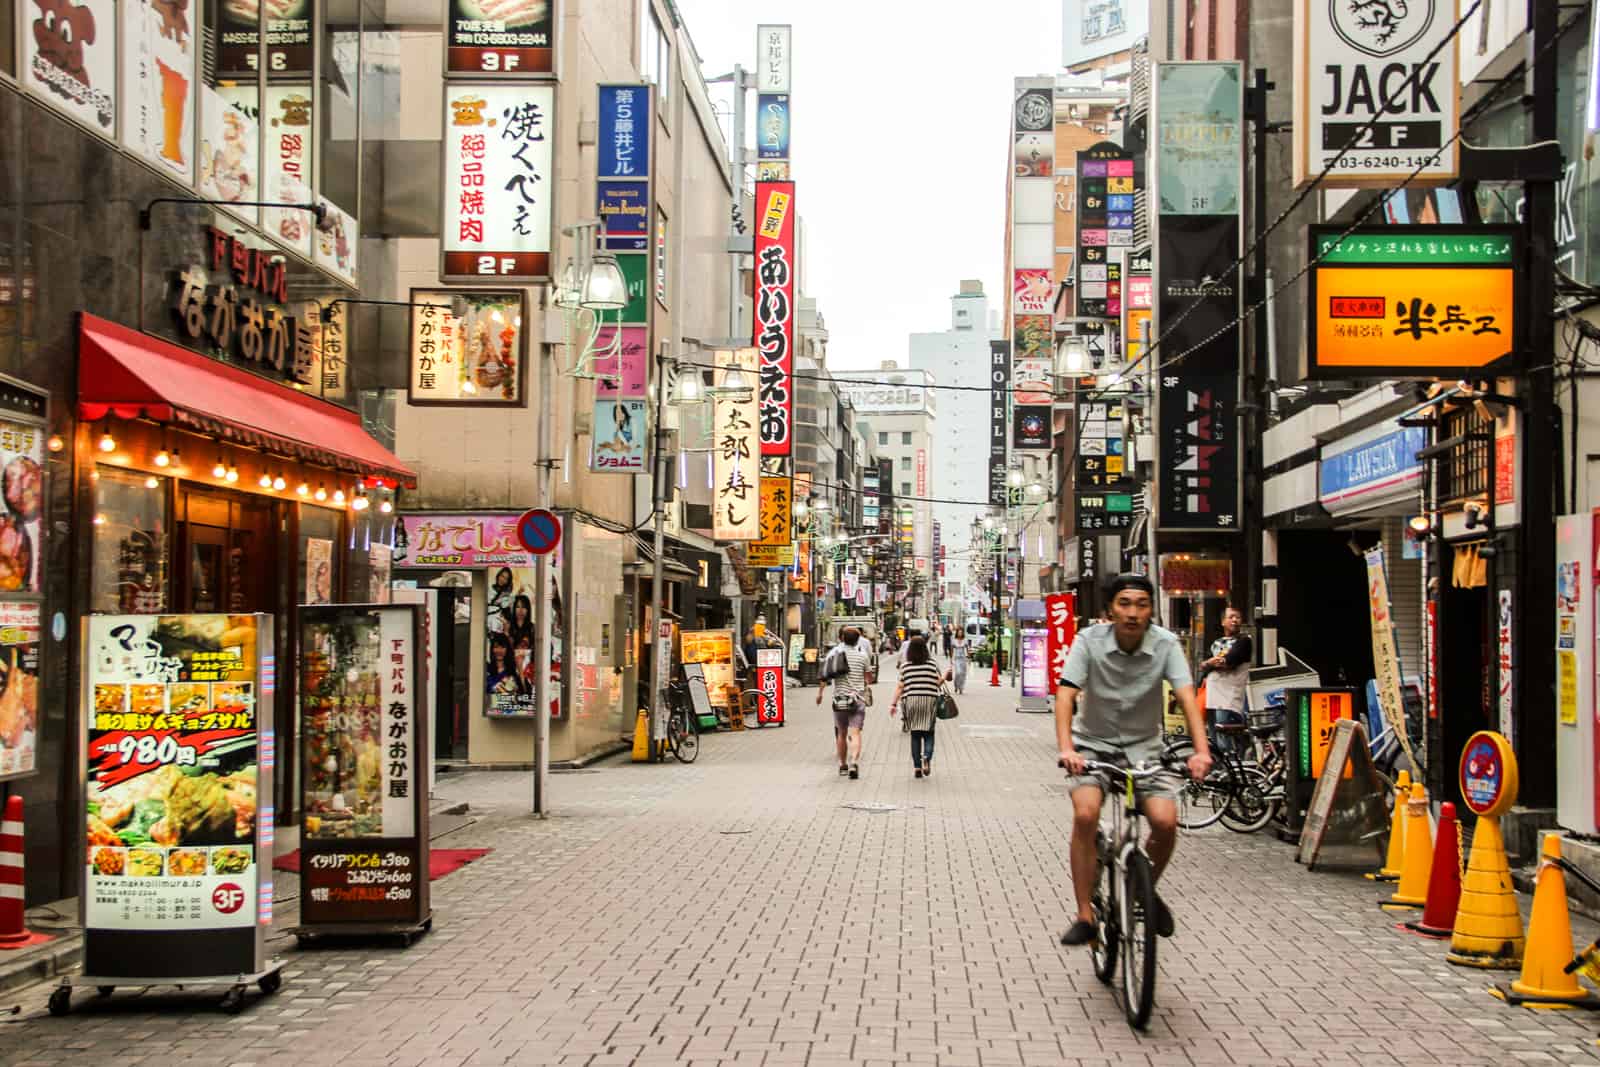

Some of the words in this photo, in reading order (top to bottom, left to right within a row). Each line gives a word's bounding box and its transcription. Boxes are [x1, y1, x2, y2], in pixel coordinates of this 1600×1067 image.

[481, 52, 521, 71] 3F
[1321, 62, 1441, 116] JACK
[614, 89, 635, 175] 第5藤井ビル
[1340, 155, 1441, 169] 03-6240-1492
[459, 133, 486, 244] 絶品焼肉
[502, 101, 545, 237] 焼くべえ
[477, 256, 516, 275] 2F
[419, 301, 437, 390] ながおか屋
[758, 245, 791, 443] あいうえお
[992, 353, 1005, 437] HOTEL
[1163, 376, 1180, 387] 3F
[598, 455, 643, 468] ショムニ
[718, 396, 755, 526] 太郎寿し
[1217, 514, 1233, 526] 3F
[387, 701, 408, 799] ながおか屋
[214, 889, 245, 909] 3F
